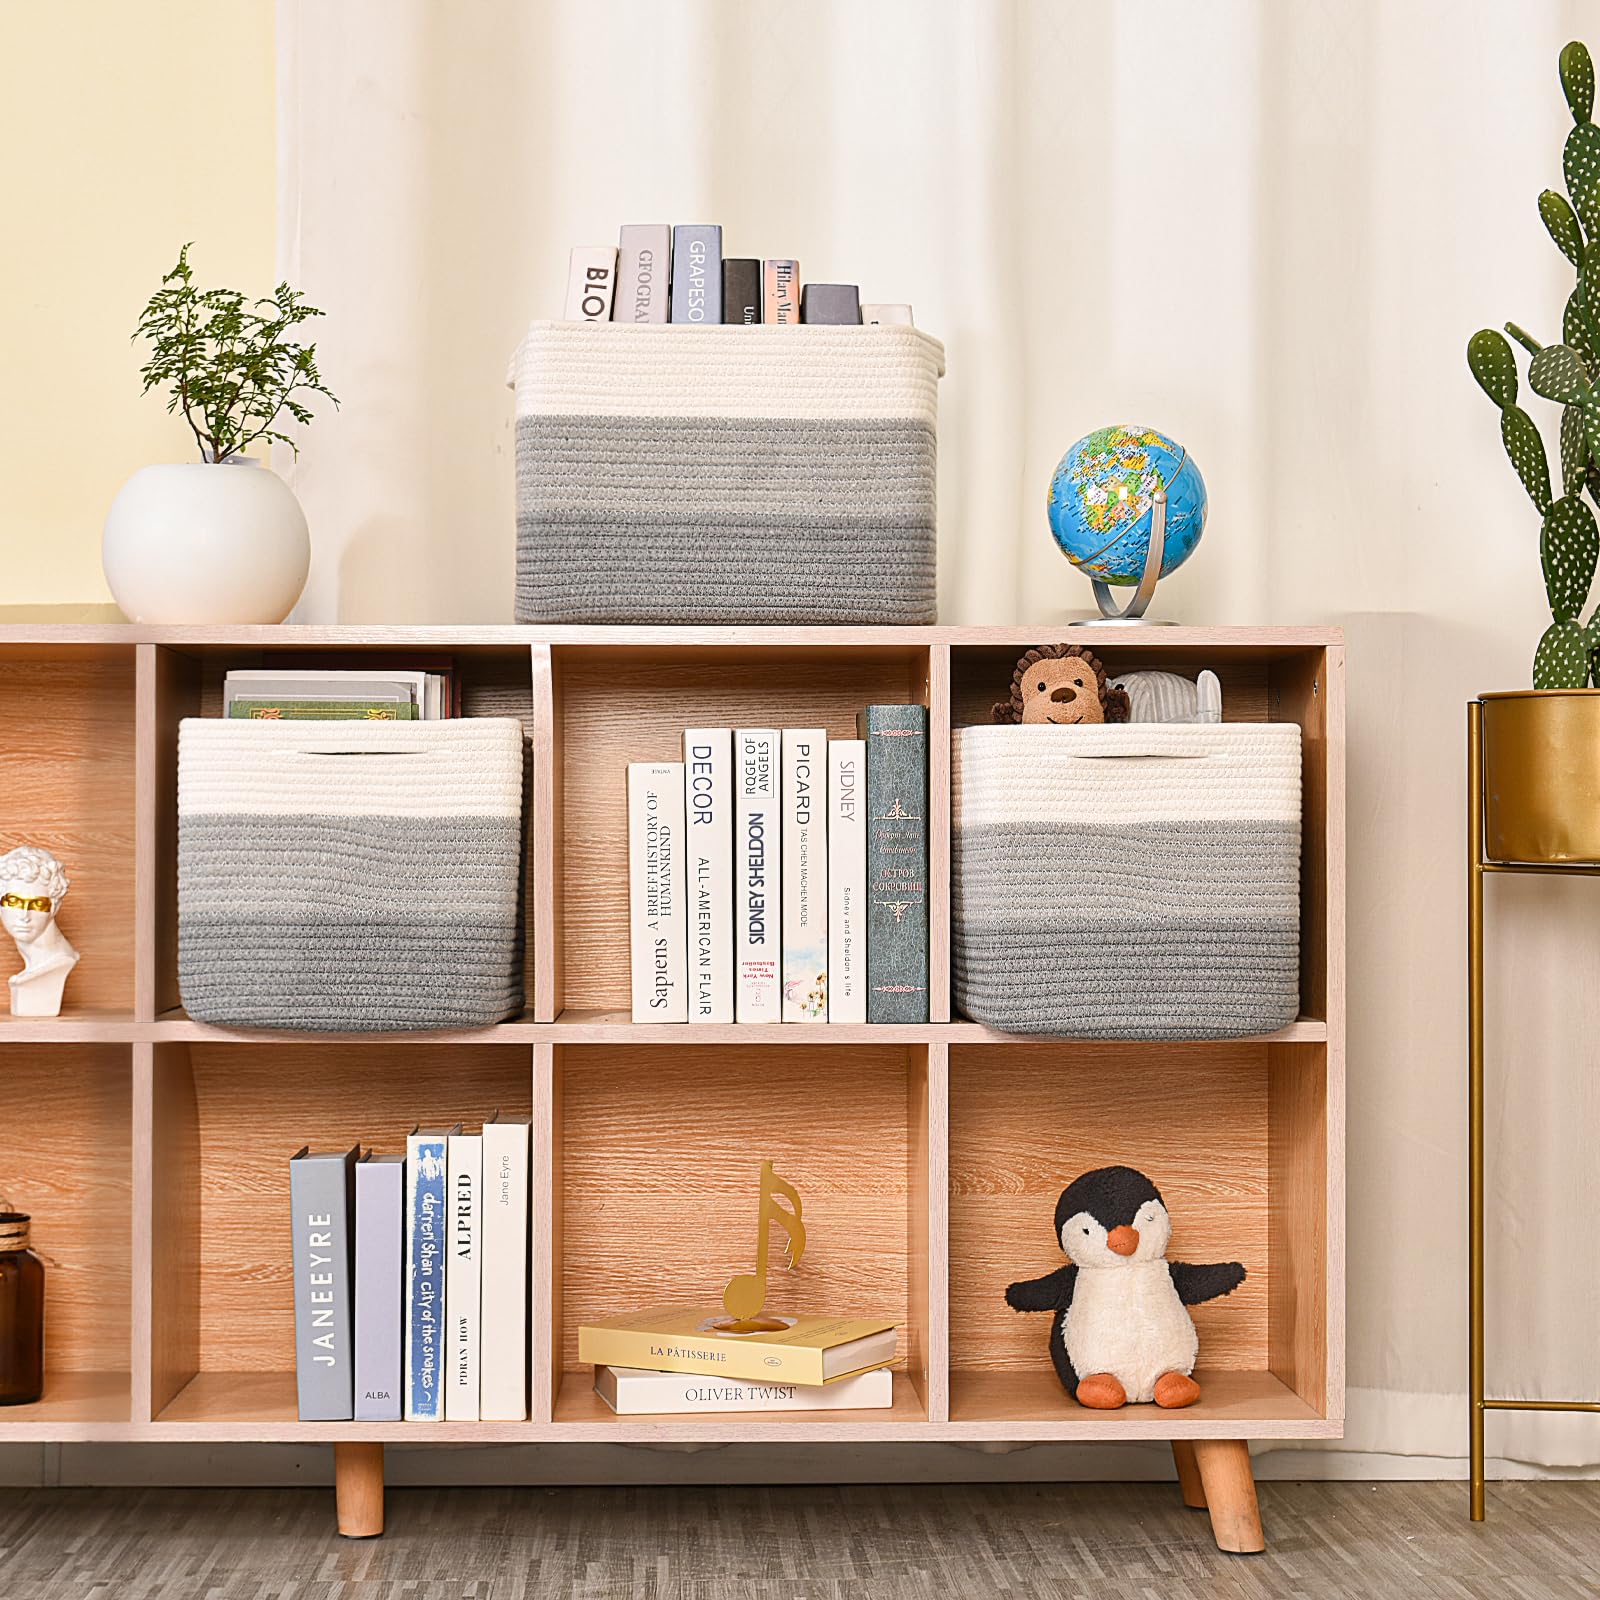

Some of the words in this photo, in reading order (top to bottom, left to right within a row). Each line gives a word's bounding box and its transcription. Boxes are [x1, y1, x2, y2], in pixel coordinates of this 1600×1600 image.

[581, 267, 609, 322] BLO
[744, 738, 756, 755] OF
[692, 745, 713, 825] DECOR
[757, 741, 769, 792] ANGELS
[797, 744, 811, 825] PICARD
[646, 790, 659, 811] OF
[839, 760, 855, 822] SIDNEY
[647, 813, 659, 874] HISTORY
[748, 813, 765, 887] SHELDON
[800, 845, 808, 867] CHEN
[660, 825, 672, 917] HUMANKIND
[800, 868, 808, 902] MACHEN
[647, 875, 659, 916] BRIEF
[698, 857, 711, 966] ALL-AMERICAN
[843, 887, 851, 916] Sidney
[647, 921, 659, 931] A
[748, 890, 765, 945] SIDNEY
[800, 904, 808, 928] MODE
[649, 938, 674, 1009] Sapiens
[844, 982, 852, 997] life
[699, 973, 712, 1015] FLAIR
[499, 1155, 512, 1179] Eyre
[499, 1181, 509, 1206] Jane
[421, 1192, 441, 1240] darren
[457, 1174, 472, 1260] ALPRED
[419, 1281, 435, 1309] city
[420, 1310, 436, 1322] of
[422, 1323, 437, 1344] the
[421, 1346, 436, 1388] snakes
[650, 1346, 664, 1357] LA
[667, 1346, 727, 1362] PÂTISSERIE
[364, 1391, 391, 1400] ALBA
[685, 1387, 744, 1402] OLIVER
[747, 1386, 797, 1400] TWIST
